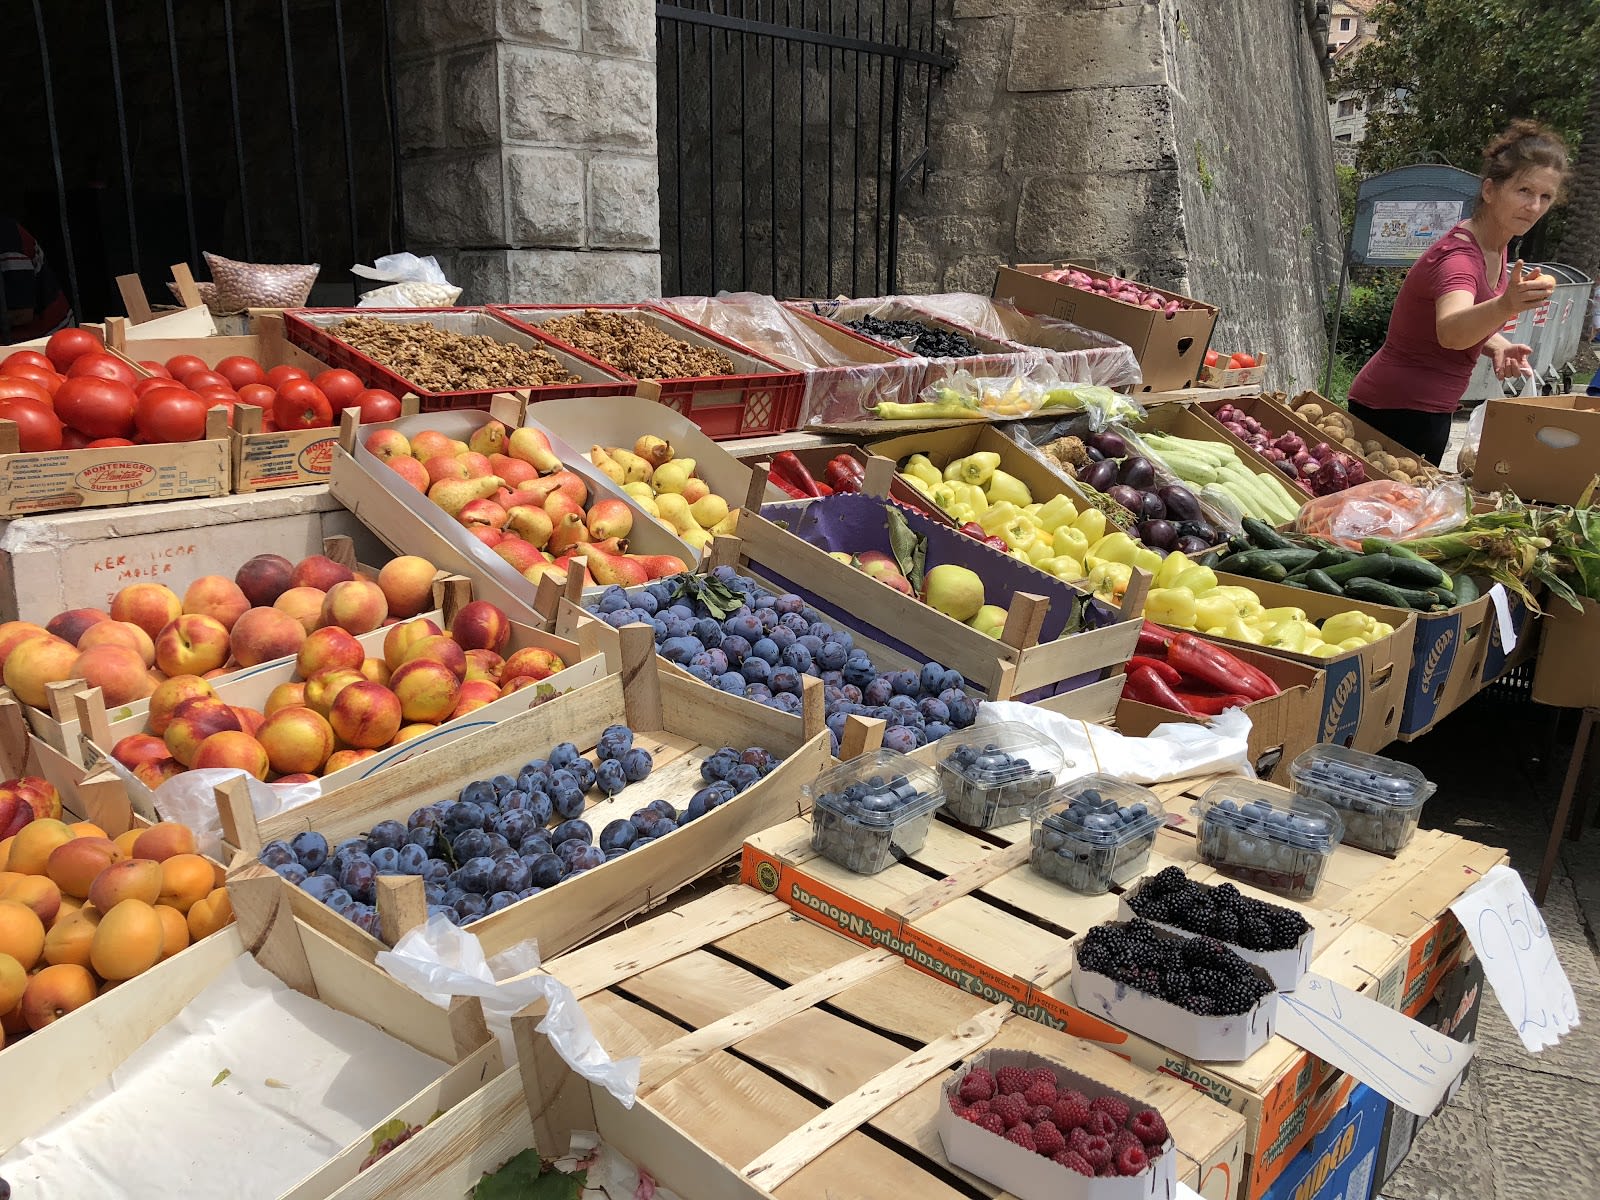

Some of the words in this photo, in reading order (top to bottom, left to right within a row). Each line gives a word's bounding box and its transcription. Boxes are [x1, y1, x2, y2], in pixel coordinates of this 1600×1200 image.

[83, 463, 152, 477] MONTENEGRO
[120, 480, 144, 490] FRUIT
[792, 884, 865, 936] Νάουσας
[1165, 1058, 1232, 1097] NAOUSSA
